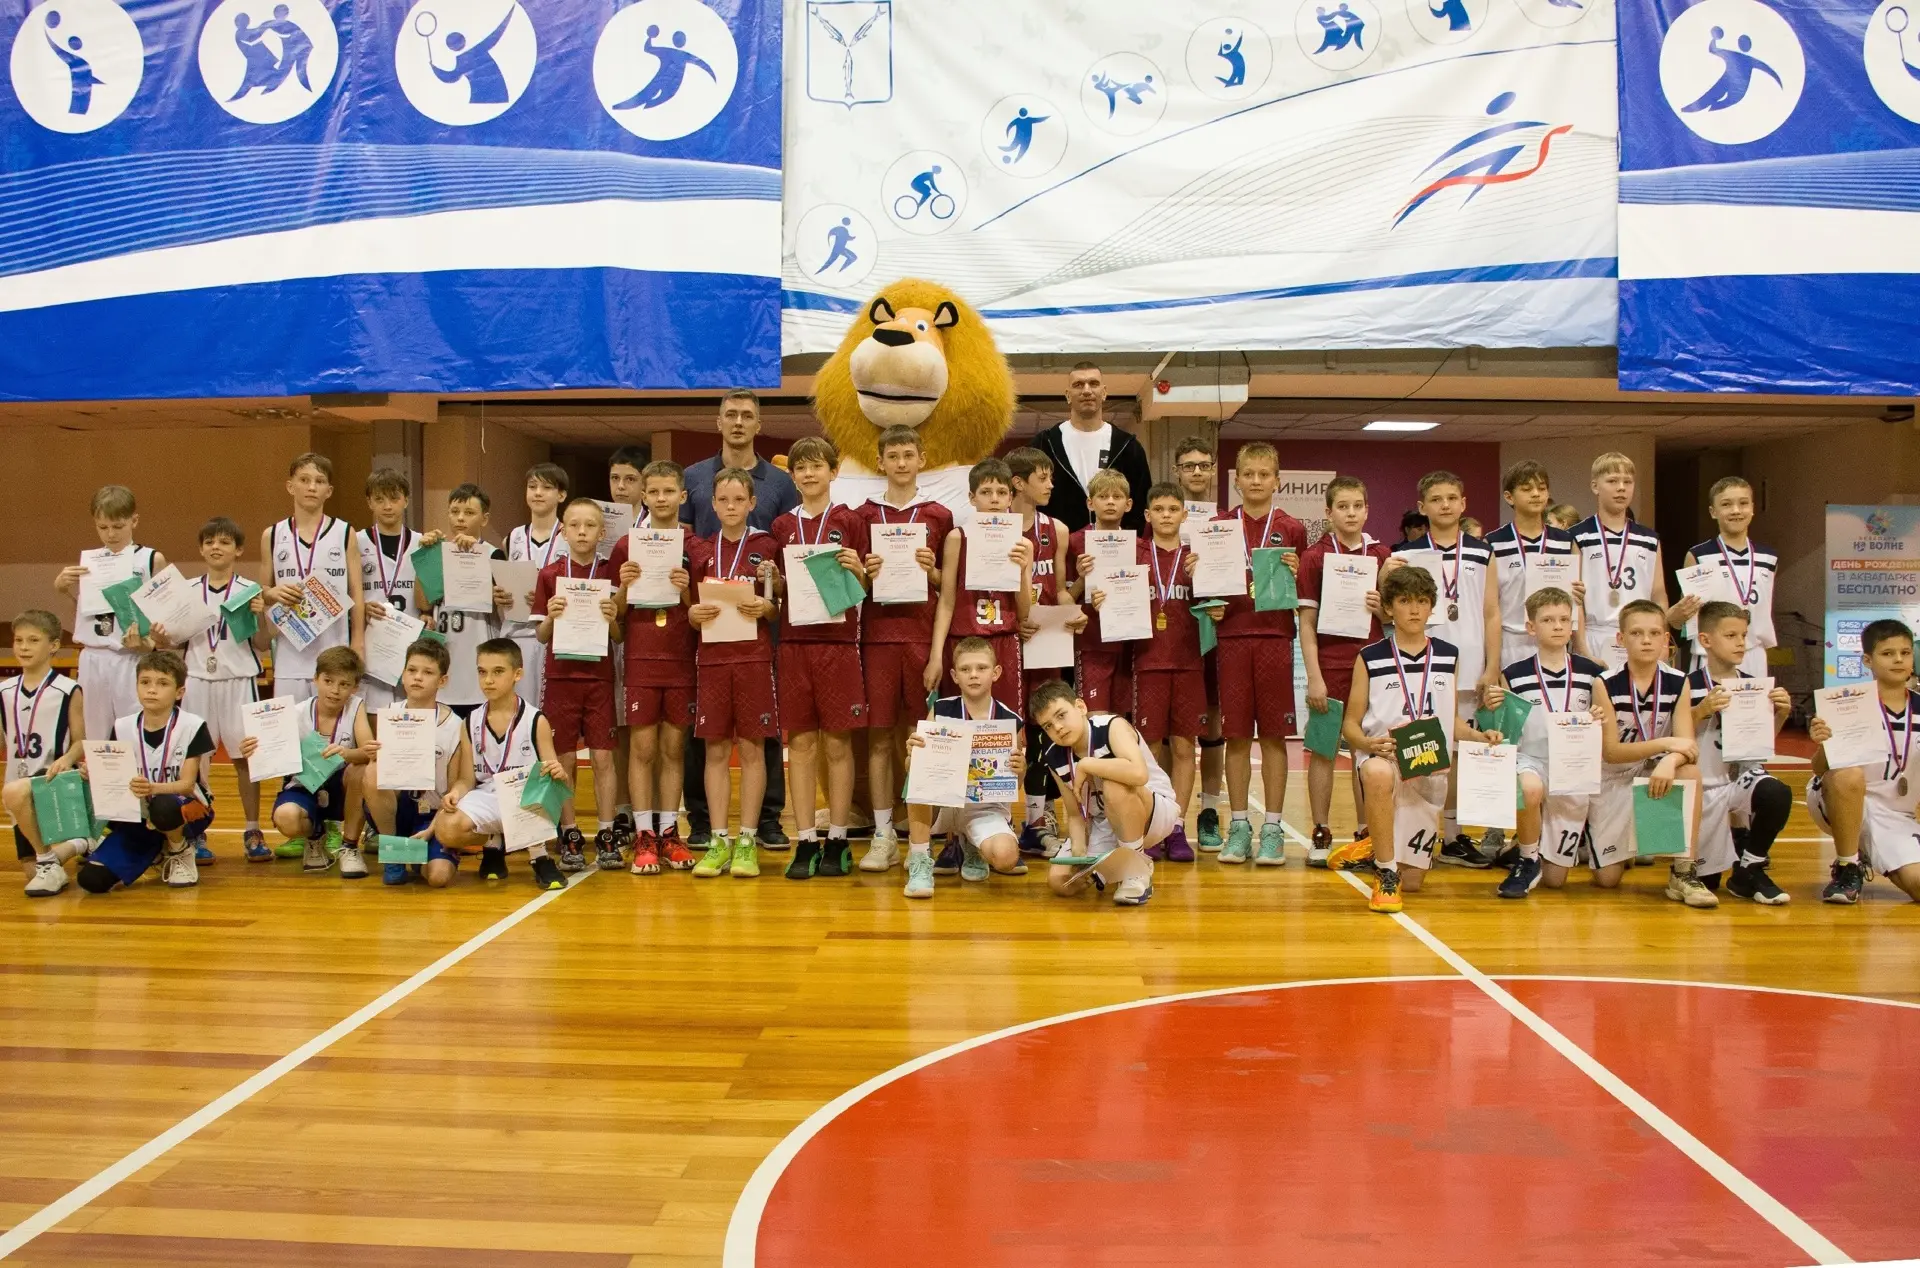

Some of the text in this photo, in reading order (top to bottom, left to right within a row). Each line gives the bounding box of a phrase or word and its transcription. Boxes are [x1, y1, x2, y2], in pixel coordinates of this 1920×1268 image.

[1277, 482, 1329, 495] ИНИР
[1869, 541, 1904, 551] ВОЛНЕ
[1508, 561, 1522, 569] AS
[1832, 560, 1862, 570] ДЕНЬ
[286, 568, 296, 577] ПО
[1837, 572, 1917, 582] В АКВАПАРКЕ
[975, 598, 1004, 625] 91
[1384, 681, 1400, 691] AS
[1401, 692, 1435, 717] 44
[972, 734, 1012, 742] ДАРОЧНЫЙ
[14, 732, 43, 759] 23
[1423, 740, 1440, 753] ЕСТЬ
[1407, 828, 1437, 858] 44
[1556, 829, 1580, 858] 12
[1602, 845, 1618, 856] AS
